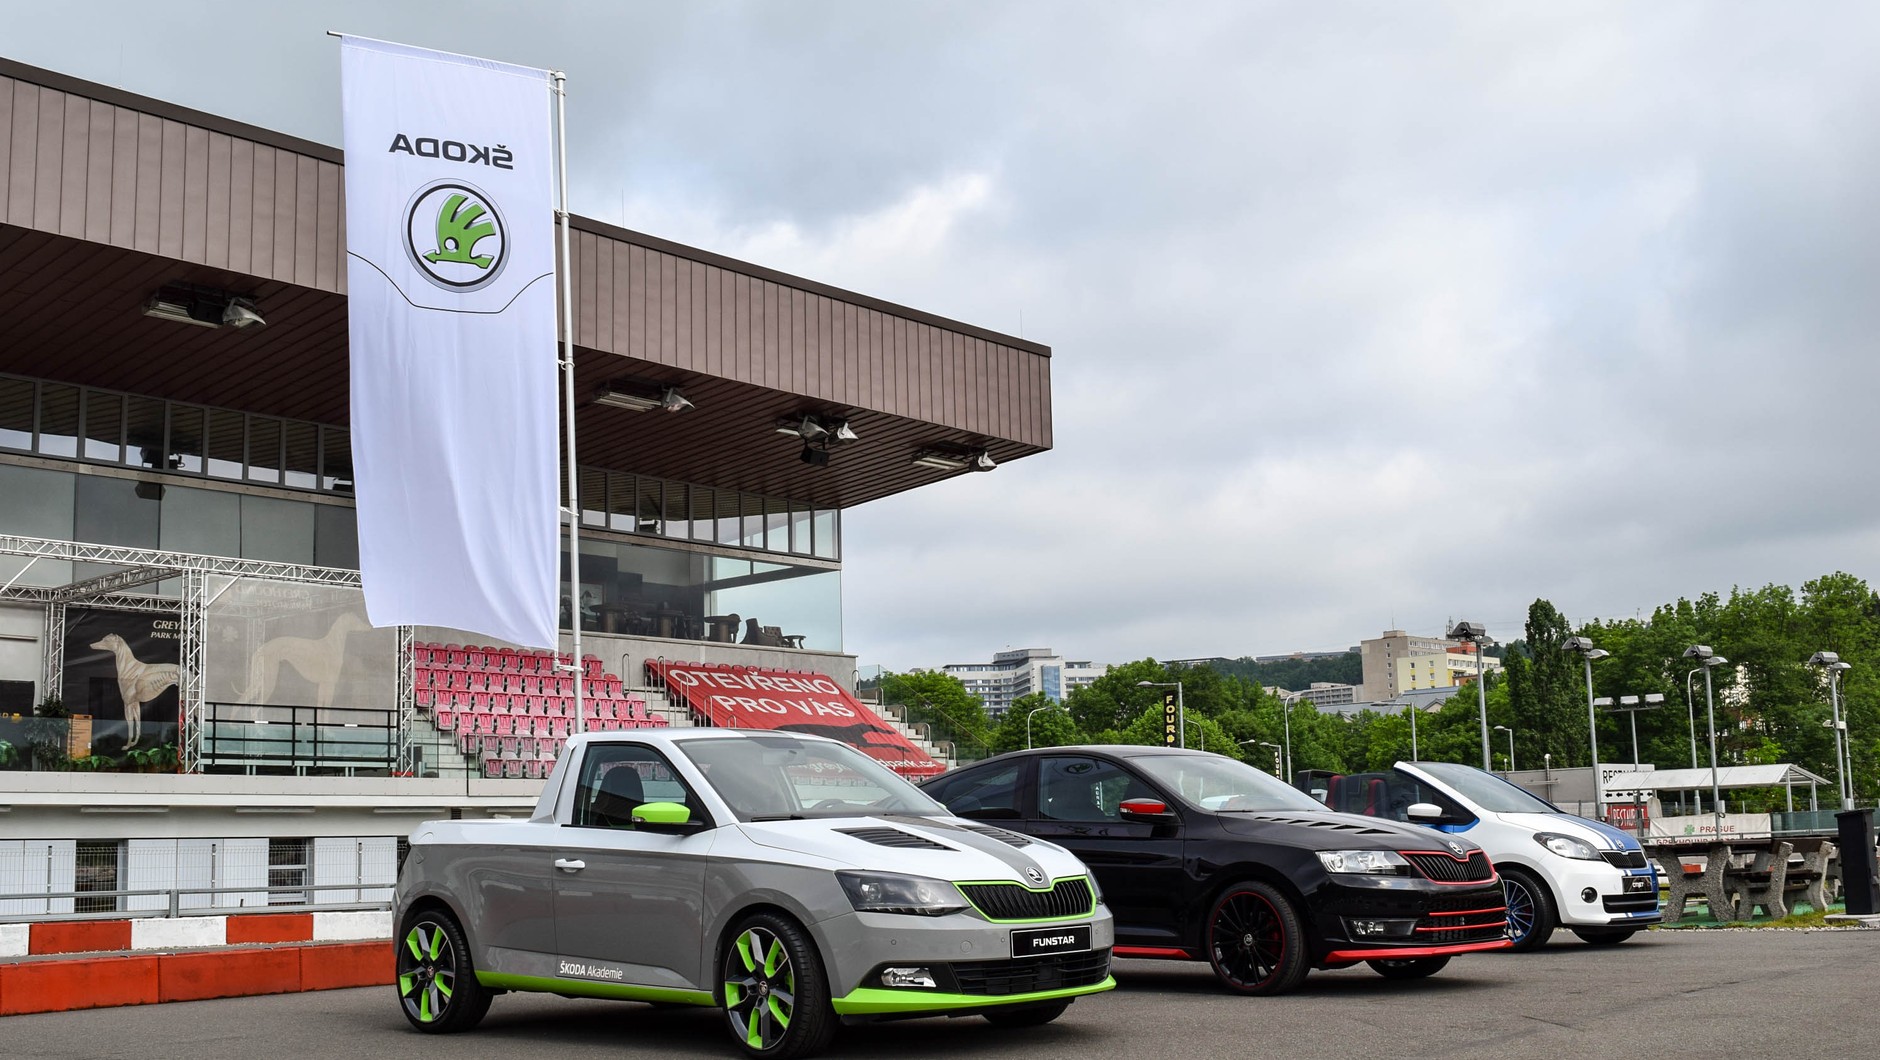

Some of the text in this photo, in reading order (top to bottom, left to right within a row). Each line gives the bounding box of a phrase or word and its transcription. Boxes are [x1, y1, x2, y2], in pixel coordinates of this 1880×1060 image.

[150, 631, 171, 640] PARK
[669, 669, 840, 695] OTEVŘENO
[712, 695, 855, 718] PRO VÁS
[1165, 695, 1176, 733] FOUR
[1699, 825, 1735, 833] PRAGUE
[1032, 935, 1075, 948] FUNSTAR
[559, 960, 623, 980] ŠKODA Akademie
